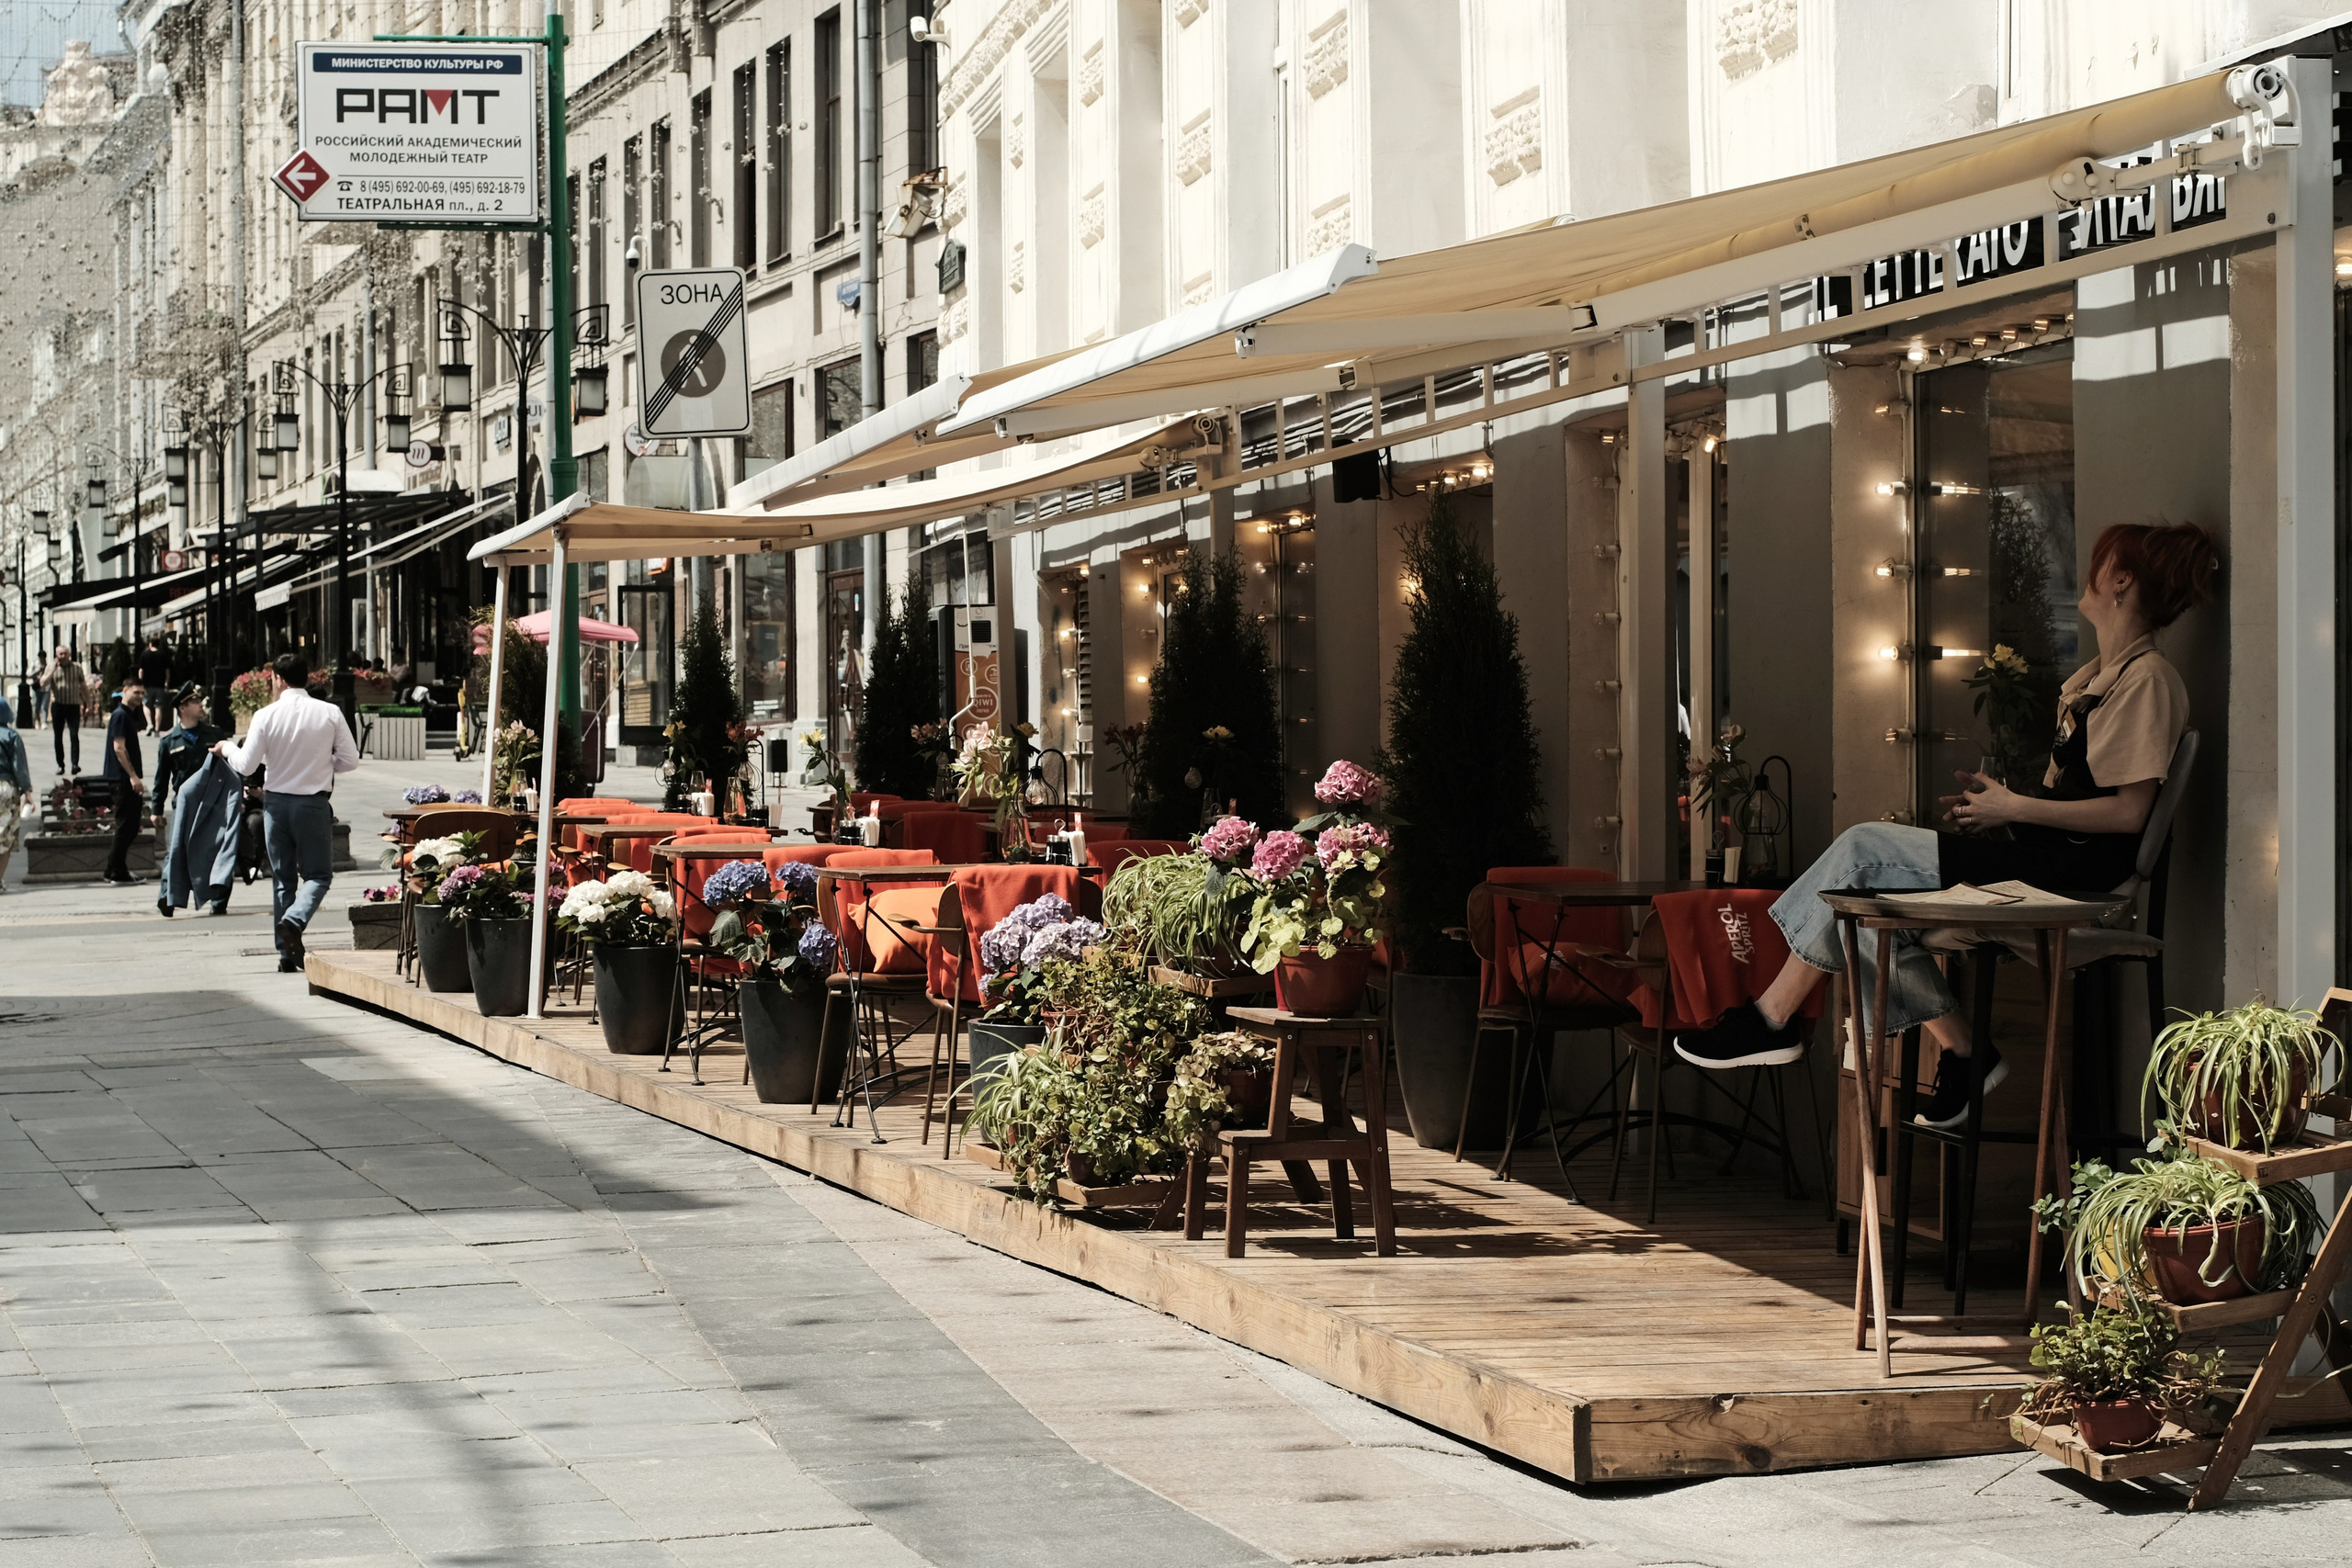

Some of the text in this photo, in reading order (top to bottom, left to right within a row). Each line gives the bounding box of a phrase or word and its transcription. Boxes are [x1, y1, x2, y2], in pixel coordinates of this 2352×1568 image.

[332, 57, 504, 71] МИНИСТЕРСТВО КУЛЬТУРЫ РФ
[335, 87, 501, 125] РАМТ
[315, 134, 523, 150] РОССИЙСКИЙ АКАДЕМИЧЕСКИЙ
[349, 151, 489, 164] МОЛОДЕЖНЫЙ ТЕАТР
[359, 180, 526, 196] 8 (495) 692-00-69, (495) 692-18-79
[336, 197, 503, 213] ТЕАТРАЛЬНАЯ пл., д. 2
[660, 283, 725, 305] ЗОНА
[1717, 903, 1749, 963] APEROL
